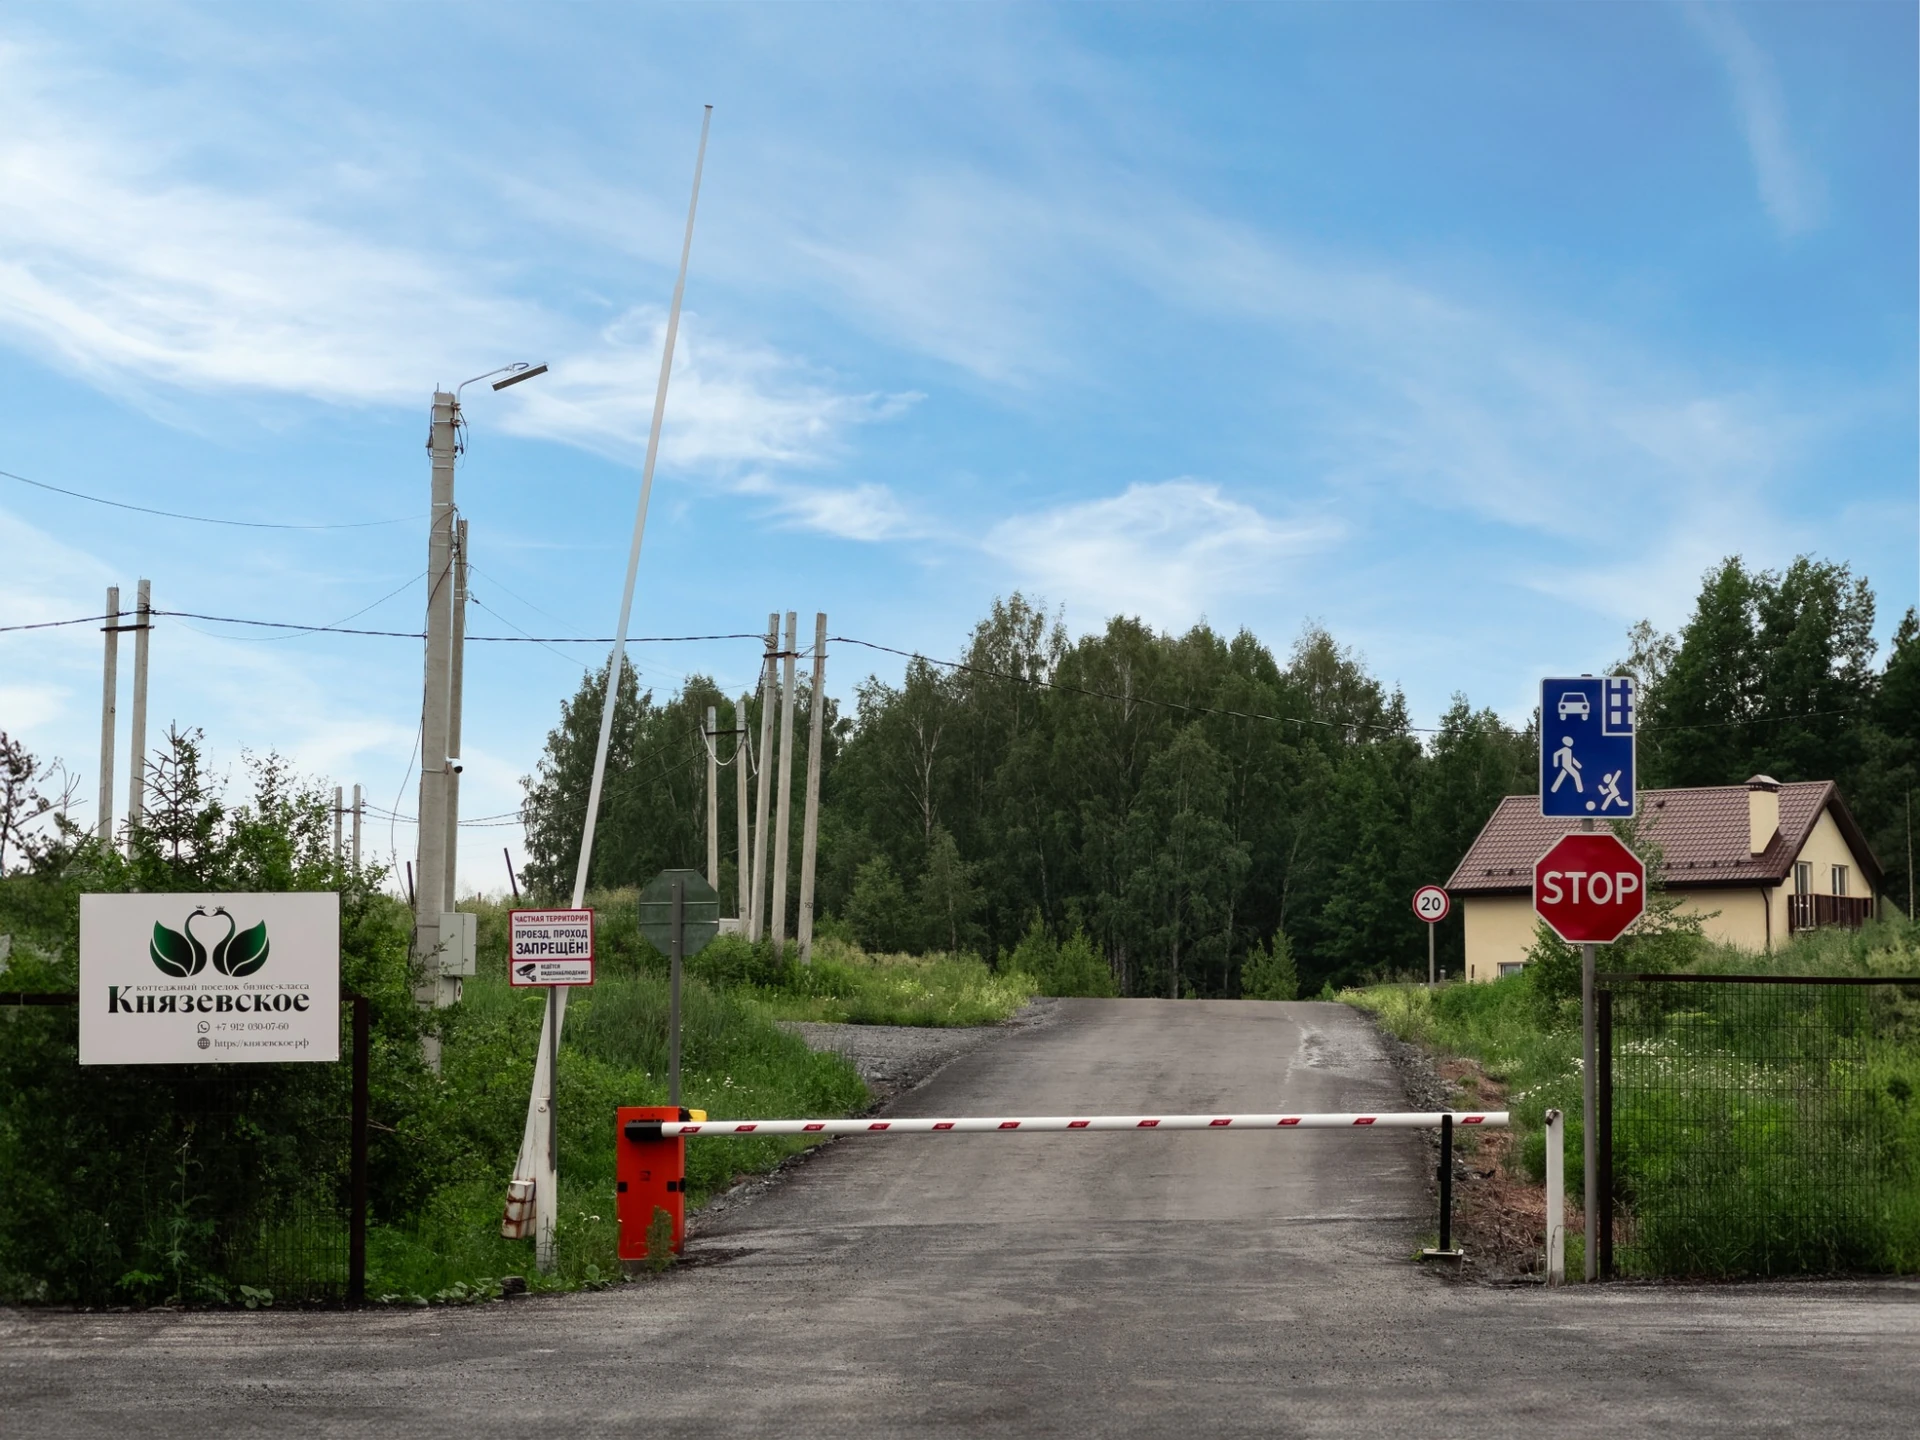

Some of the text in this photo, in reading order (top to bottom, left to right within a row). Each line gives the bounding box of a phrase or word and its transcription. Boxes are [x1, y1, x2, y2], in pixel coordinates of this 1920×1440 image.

[1541, 871, 1639, 905] STOP
[1421, 896, 1441, 911] 20
[515, 929, 588, 939] ПРОЕЗД, ПРОХОД
[516, 939, 588, 955] ЗАПРЕЩЁН!
[136, 982, 310, 991] коттеджный поселок бизнес-класса
[108, 985, 310, 1013] Князевское
[215, 1022, 226, 1031] +7
[230, 1022, 245, 1031] 912
